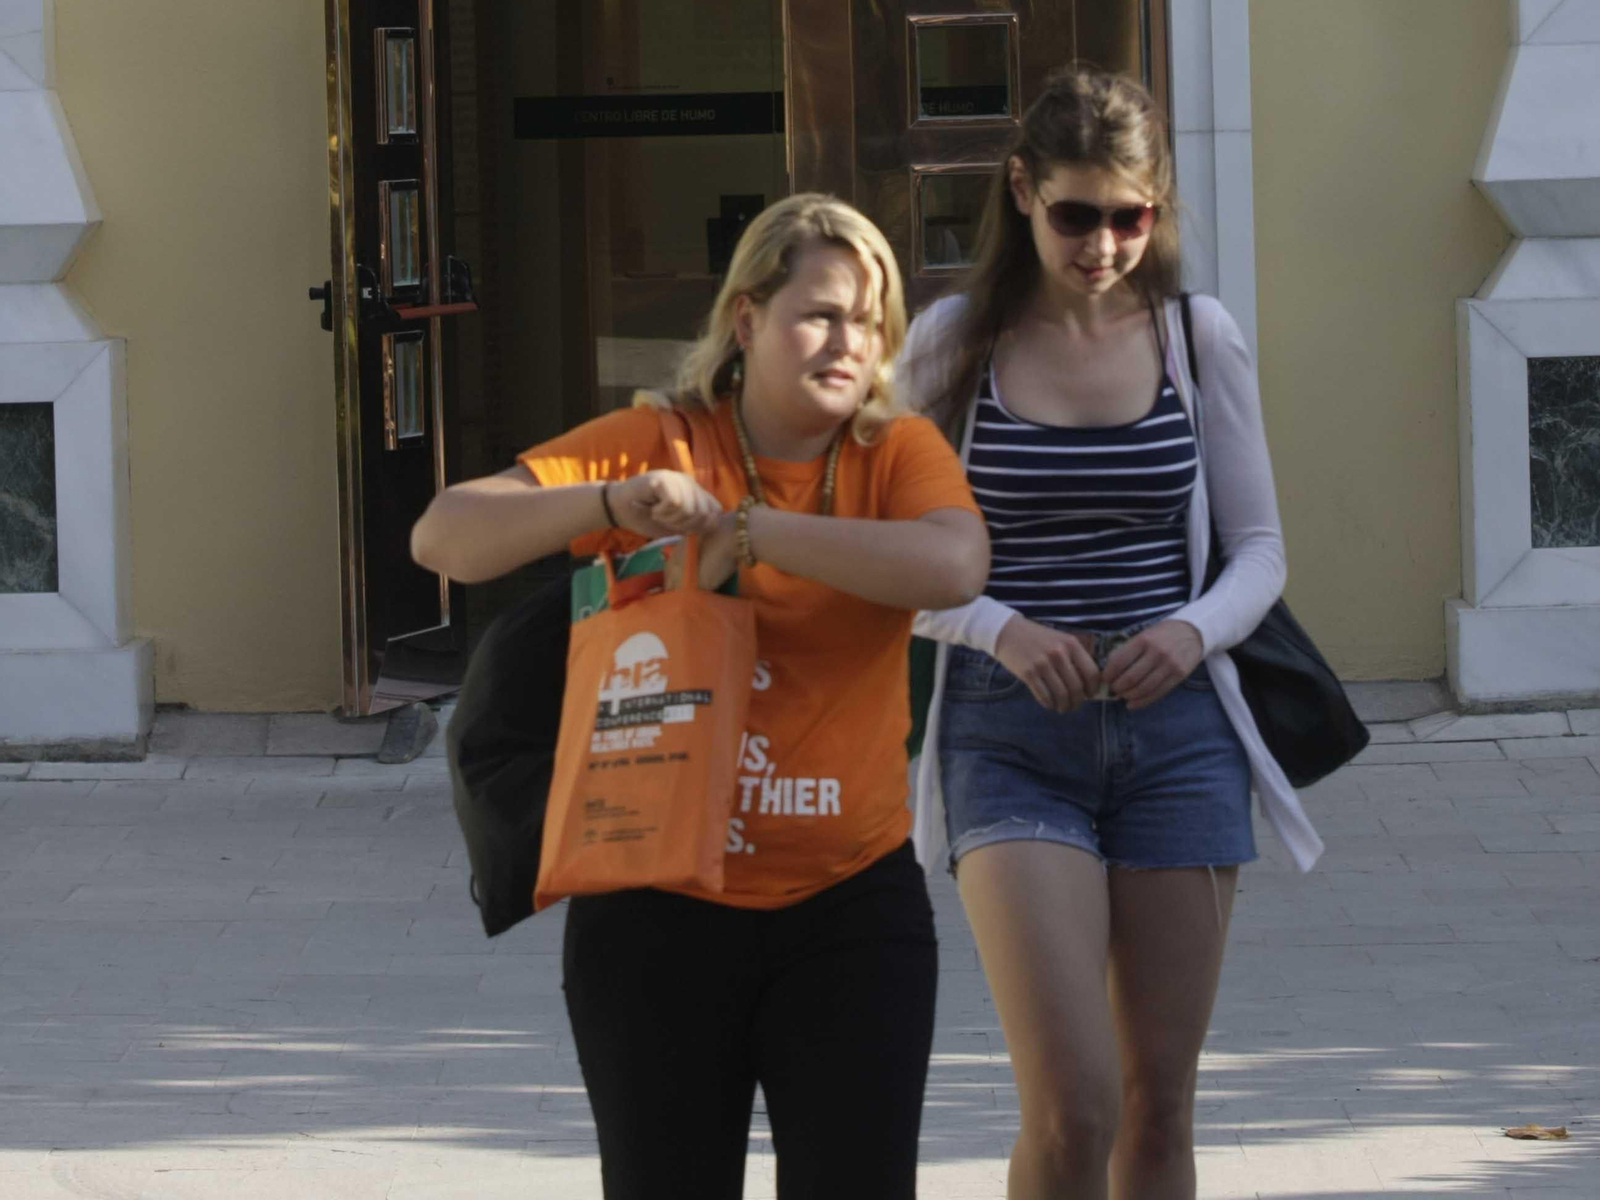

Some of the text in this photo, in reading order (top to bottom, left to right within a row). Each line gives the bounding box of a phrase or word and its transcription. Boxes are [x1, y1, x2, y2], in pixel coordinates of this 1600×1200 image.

[574, 108, 716, 123] CENTRO LIBRE DE HUMO
